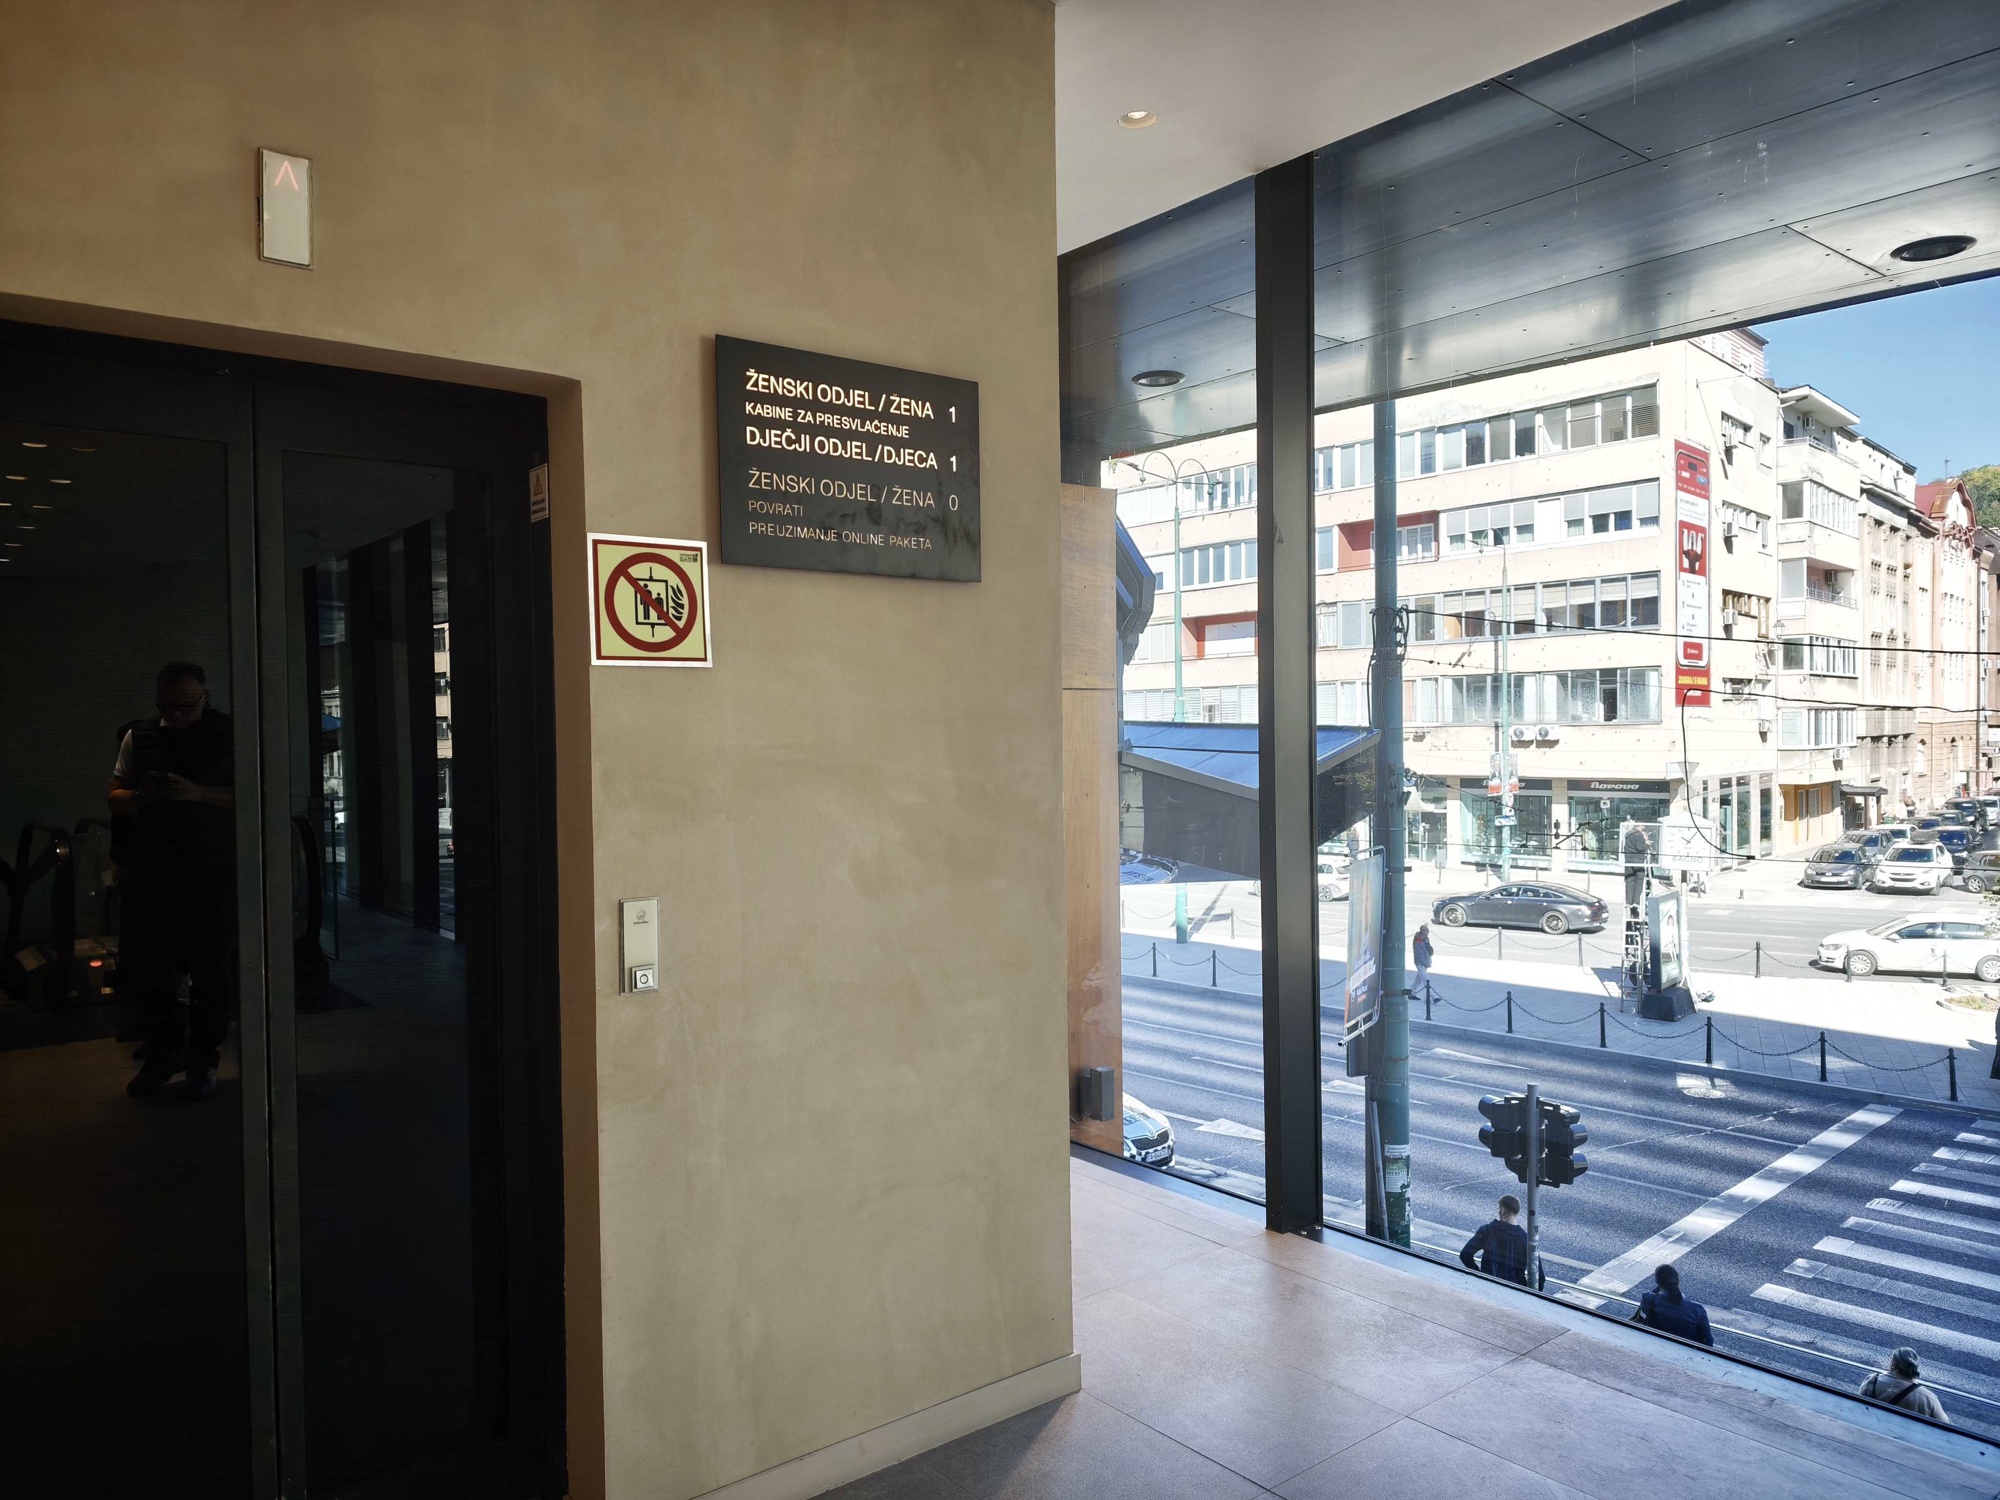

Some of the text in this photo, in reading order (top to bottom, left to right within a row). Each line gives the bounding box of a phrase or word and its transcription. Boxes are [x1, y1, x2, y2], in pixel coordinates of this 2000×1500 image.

[745, 368, 813, 400] ŽENSKI
[816, 384, 875, 411] ODJEL
[889, 393, 935, 420] ŽENA
[948, 405, 956, 423] 1
[745, 401, 910, 439] KABINE ZA PRESVLAČENJE
[746, 426, 810, 453] DJEČJI
[814, 436, 873, 461] ODJEL
[883, 445, 939, 470] DJECA
[949, 455, 957, 473] 1
[748, 466, 815, 495] ŽENSKI
[820, 479, 877, 502] ODJEL
[892, 484, 936, 509] ŽENA
[948, 494, 959, 511] 0
[748, 499, 803, 517] POVRATI
[749, 521, 933, 550] PREUZIMANJE ONLINE PAKETA
